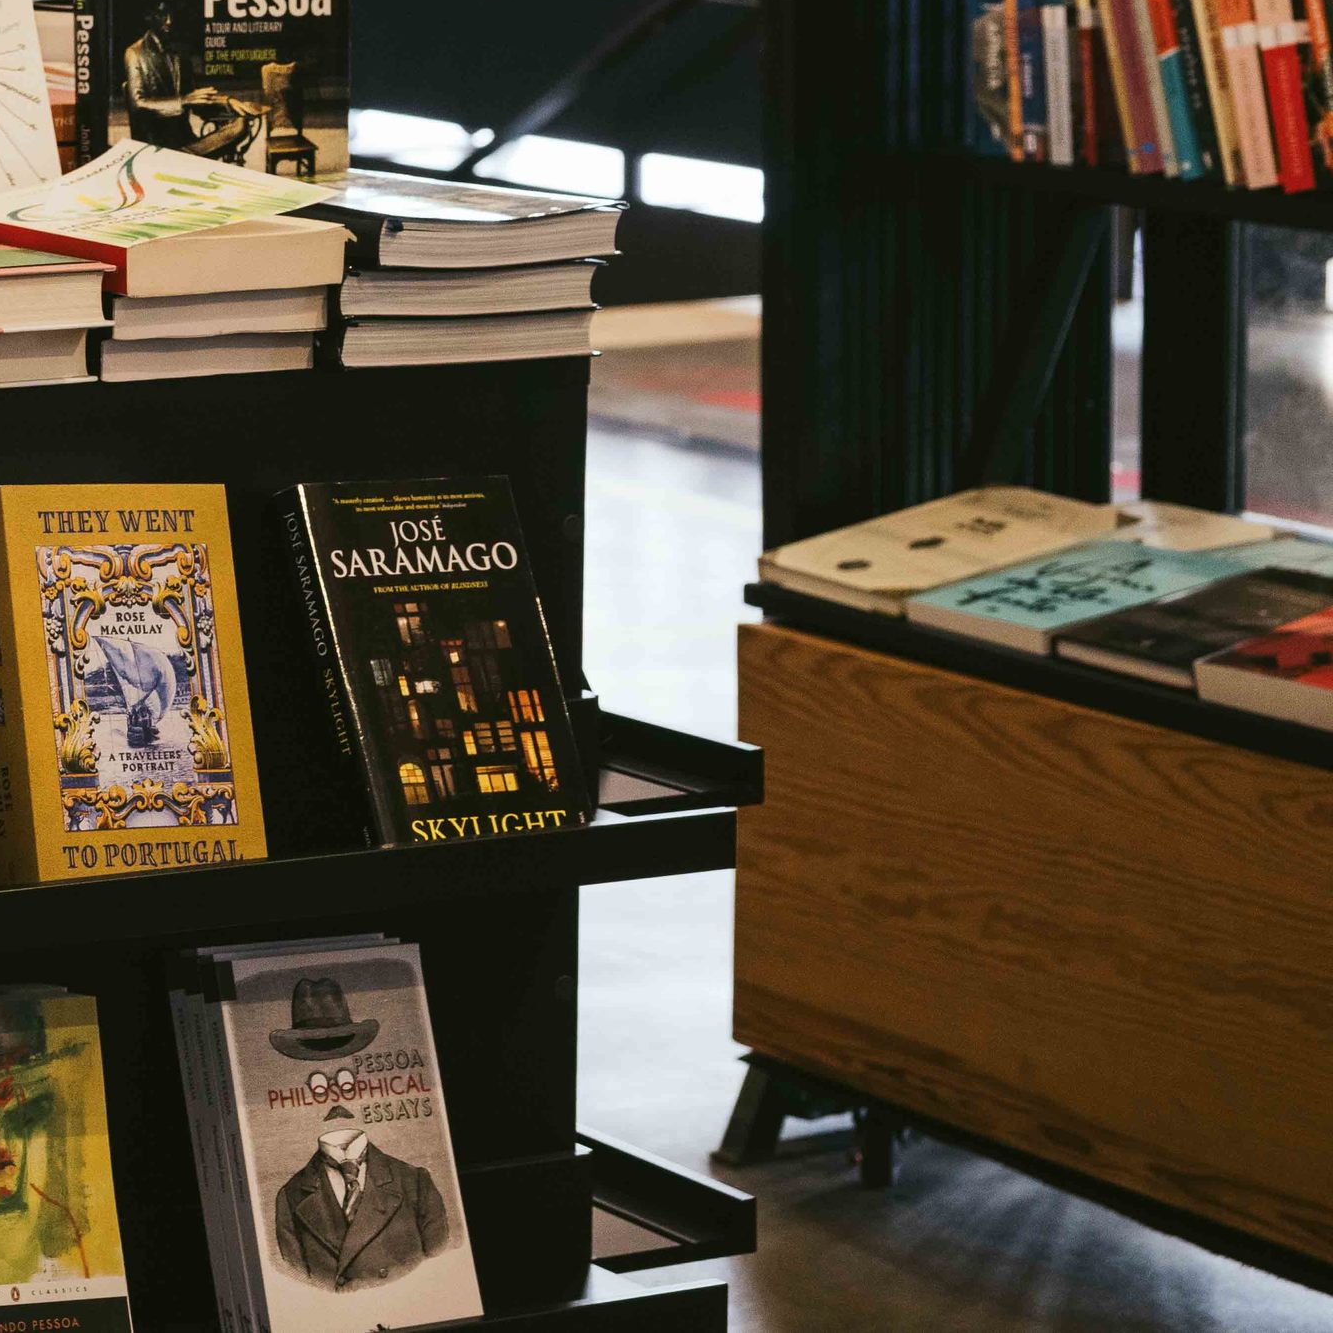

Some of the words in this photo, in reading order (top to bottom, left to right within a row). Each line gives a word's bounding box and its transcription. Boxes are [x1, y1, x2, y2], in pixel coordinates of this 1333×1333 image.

[77, 15, 93, 94] Pessoa
[38, 510, 109, 534] THEY
[117, 510, 195, 533] WENT
[390, 515, 447, 548] JOSÉ
[331, 542, 518, 578] SARAMAGO
[374, 586, 394, 594] FROM
[411, 584, 440, 592] AUTHOR
[100, 623, 163, 636] MACAULAY
[116, 612, 146, 622] ROSE
[283, 511, 303, 551] JOSÉ
[295, 554, 328, 657] SARAMAGO
[322, 667, 353, 756] SKYLIGHT
[108, 752, 117, 761] A
[122, 761, 175, 772] PORTRAIT
[0, 766, 12, 813] ROSE
[411, 810, 567, 842] SKYLIGHT
[63, 844, 98, 869] TO
[104, 839, 243, 867] PORTUGAL
[352, 1049, 425, 1075] PESSOA
[268, 1072, 431, 1109] PHILOSOPHICAL
[361, 1096, 433, 1125] ESSAYS
[31, 1286, 88, 1296] CLASSICS
[32, 1317, 81, 1330] PESSOA
